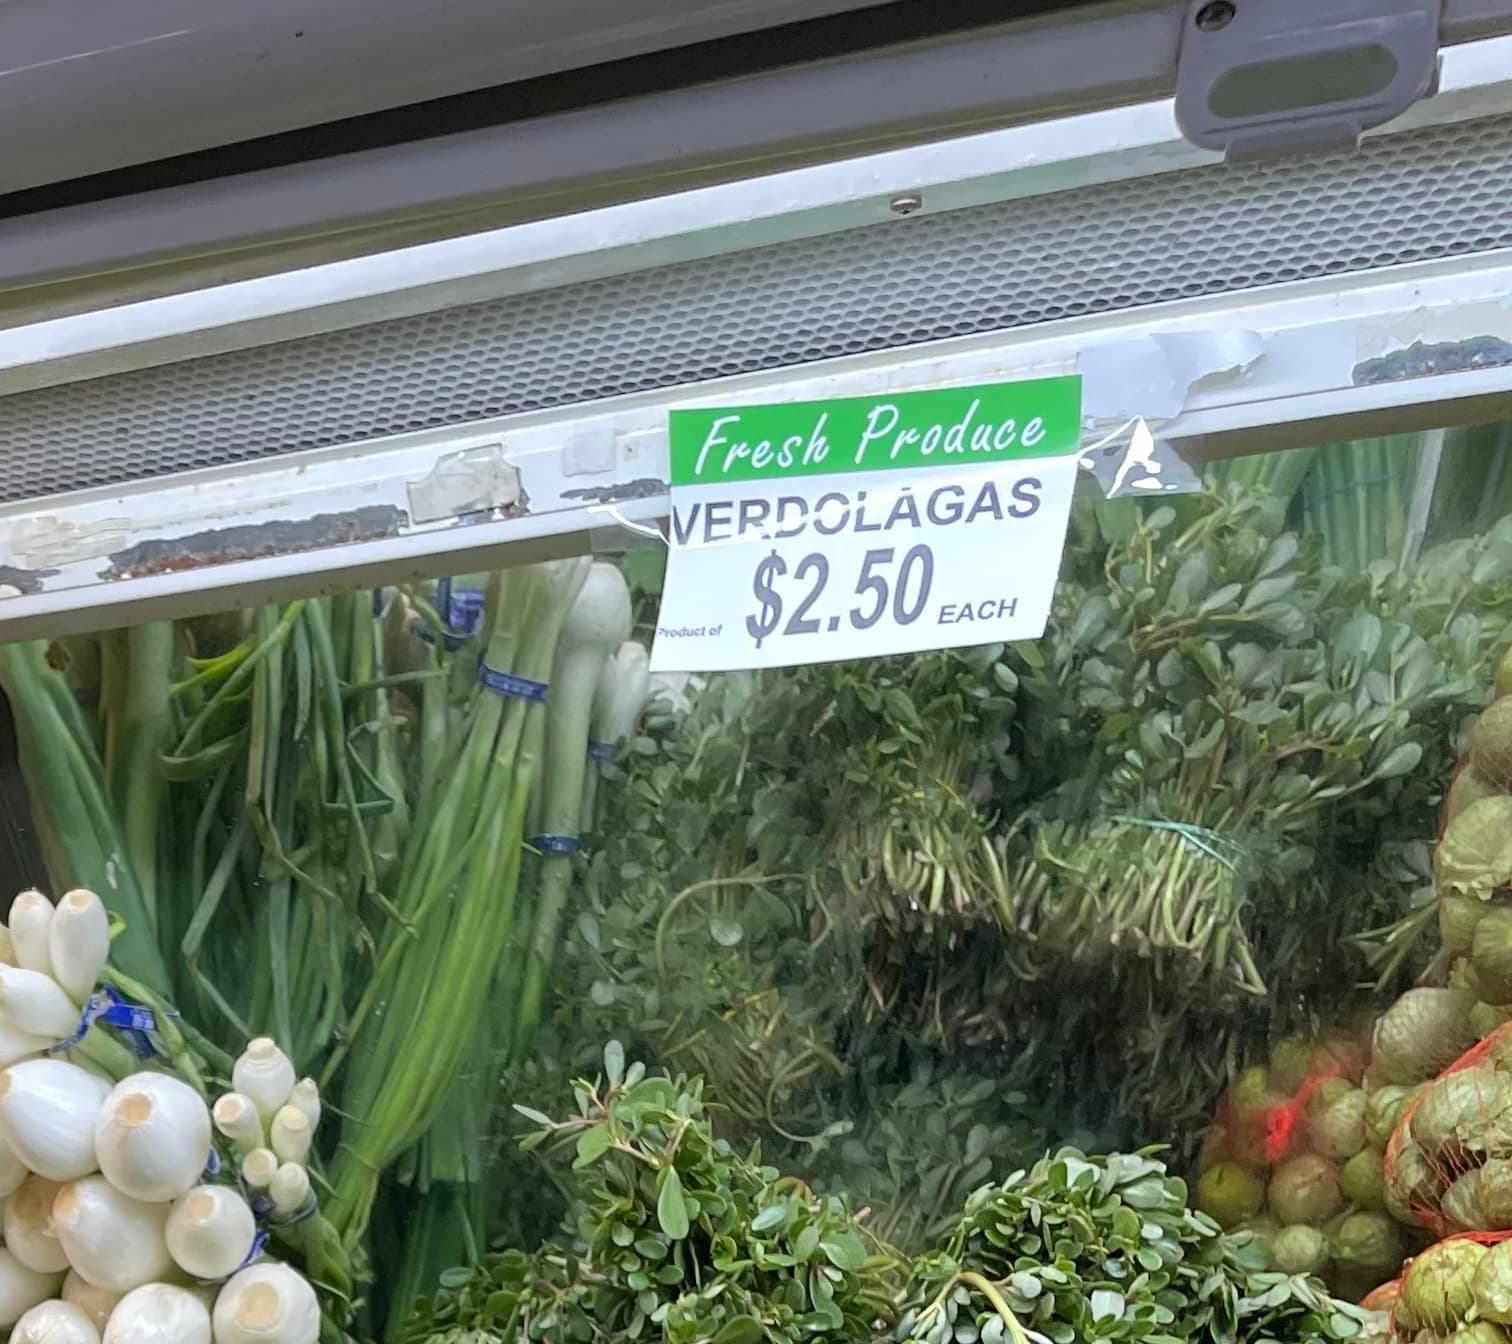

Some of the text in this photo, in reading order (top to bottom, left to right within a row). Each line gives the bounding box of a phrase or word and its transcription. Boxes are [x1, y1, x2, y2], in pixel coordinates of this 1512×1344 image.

[694, 399, 1046, 475] Fresh Produce
[673, 476, 1043, 546] VERDOLAGAS
[745, 543, 935, 649] $2.50
[937, 597, 1018, 625] EACH
